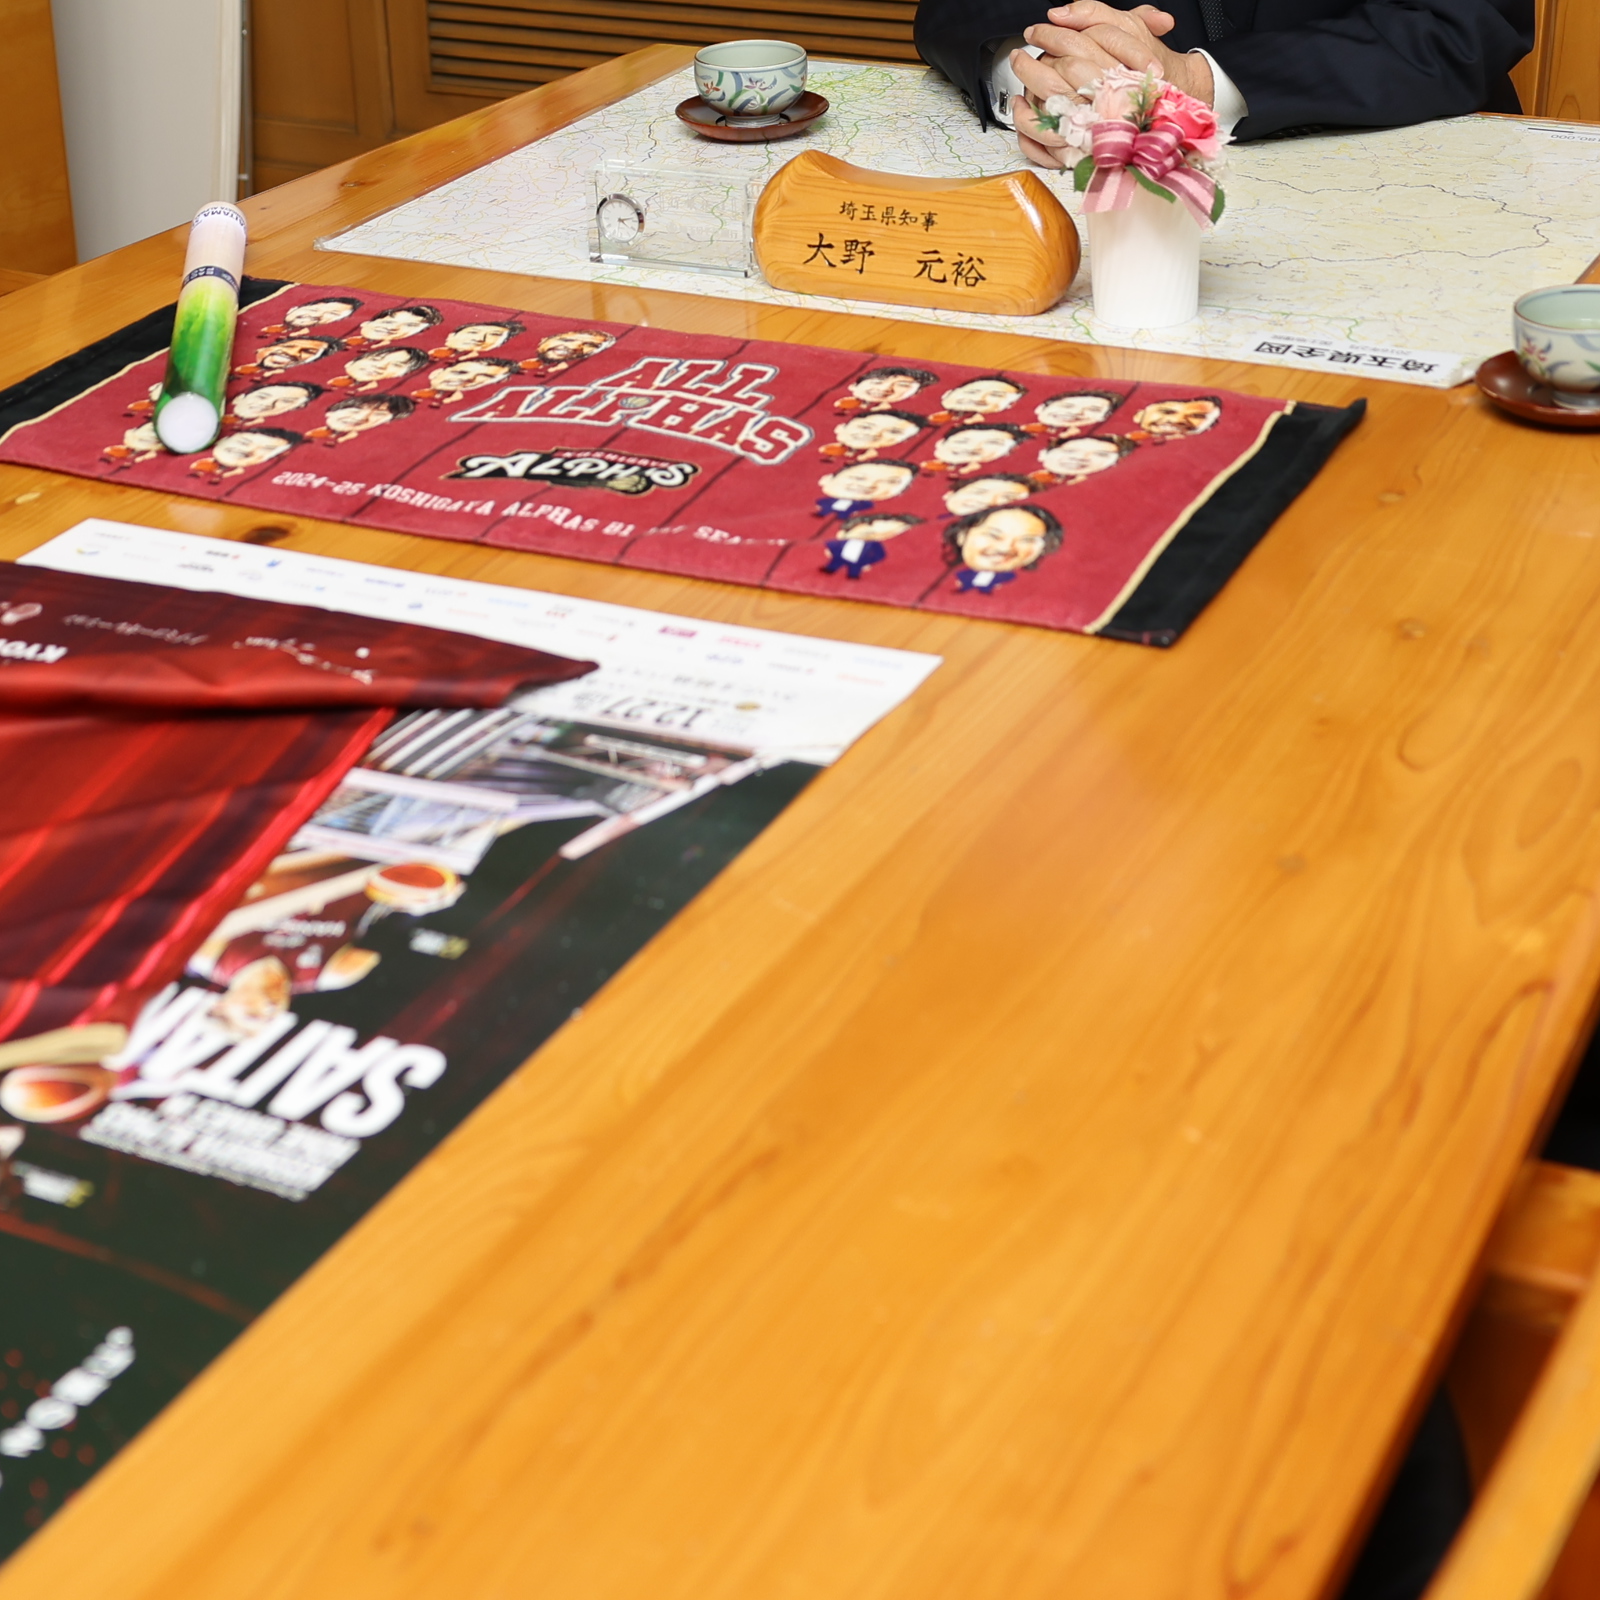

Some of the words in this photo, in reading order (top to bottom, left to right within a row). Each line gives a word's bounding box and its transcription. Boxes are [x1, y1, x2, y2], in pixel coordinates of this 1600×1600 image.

[839, 200, 938, 232] 埼玉県知事
[803, 232, 875, 275] 大野
[914, 249, 987, 289] 元裕
[590, 356, 780, 411] ALL
[446, 385, 816, 466] ALPHAS
[272, 470, 365, 496] 2024-25
[367, 484, 497, 516] KOSHIGAYA
[501, 501, 599, 533] ALPHAS
[603, 521, 635, 538] B1
[600, 697, 710, 730] 12.27
